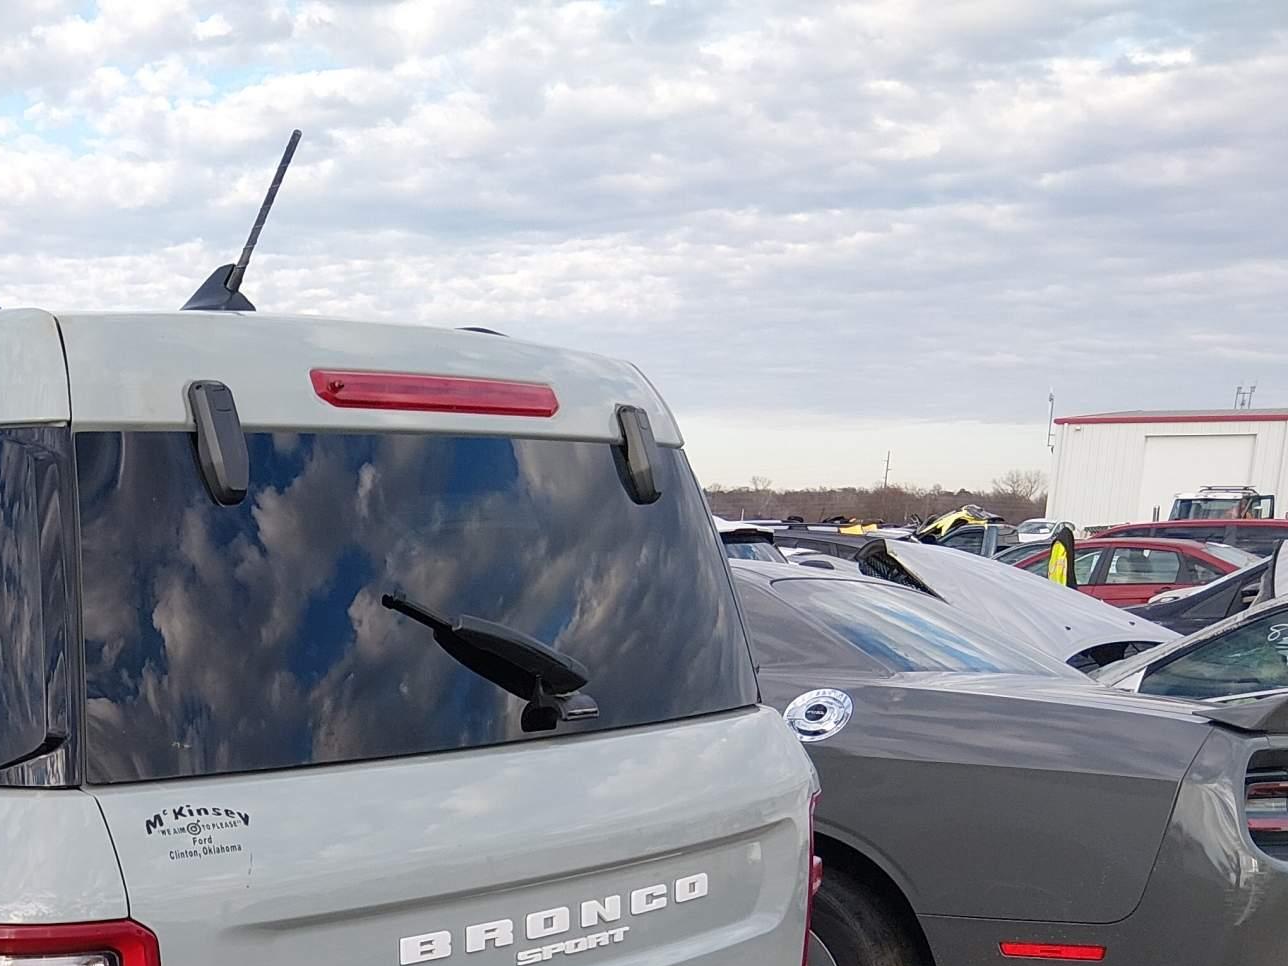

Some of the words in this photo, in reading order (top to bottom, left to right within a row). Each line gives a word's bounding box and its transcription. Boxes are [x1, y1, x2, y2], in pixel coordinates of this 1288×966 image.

[169, 850, 202, 860] Clinton,
[202, 843, 242, 856] Oklahoma
[192, 835, 213, 846] Ford
[398, 872, 710, 966] BRONCO
[516, 926, 630, 966] SPORT
